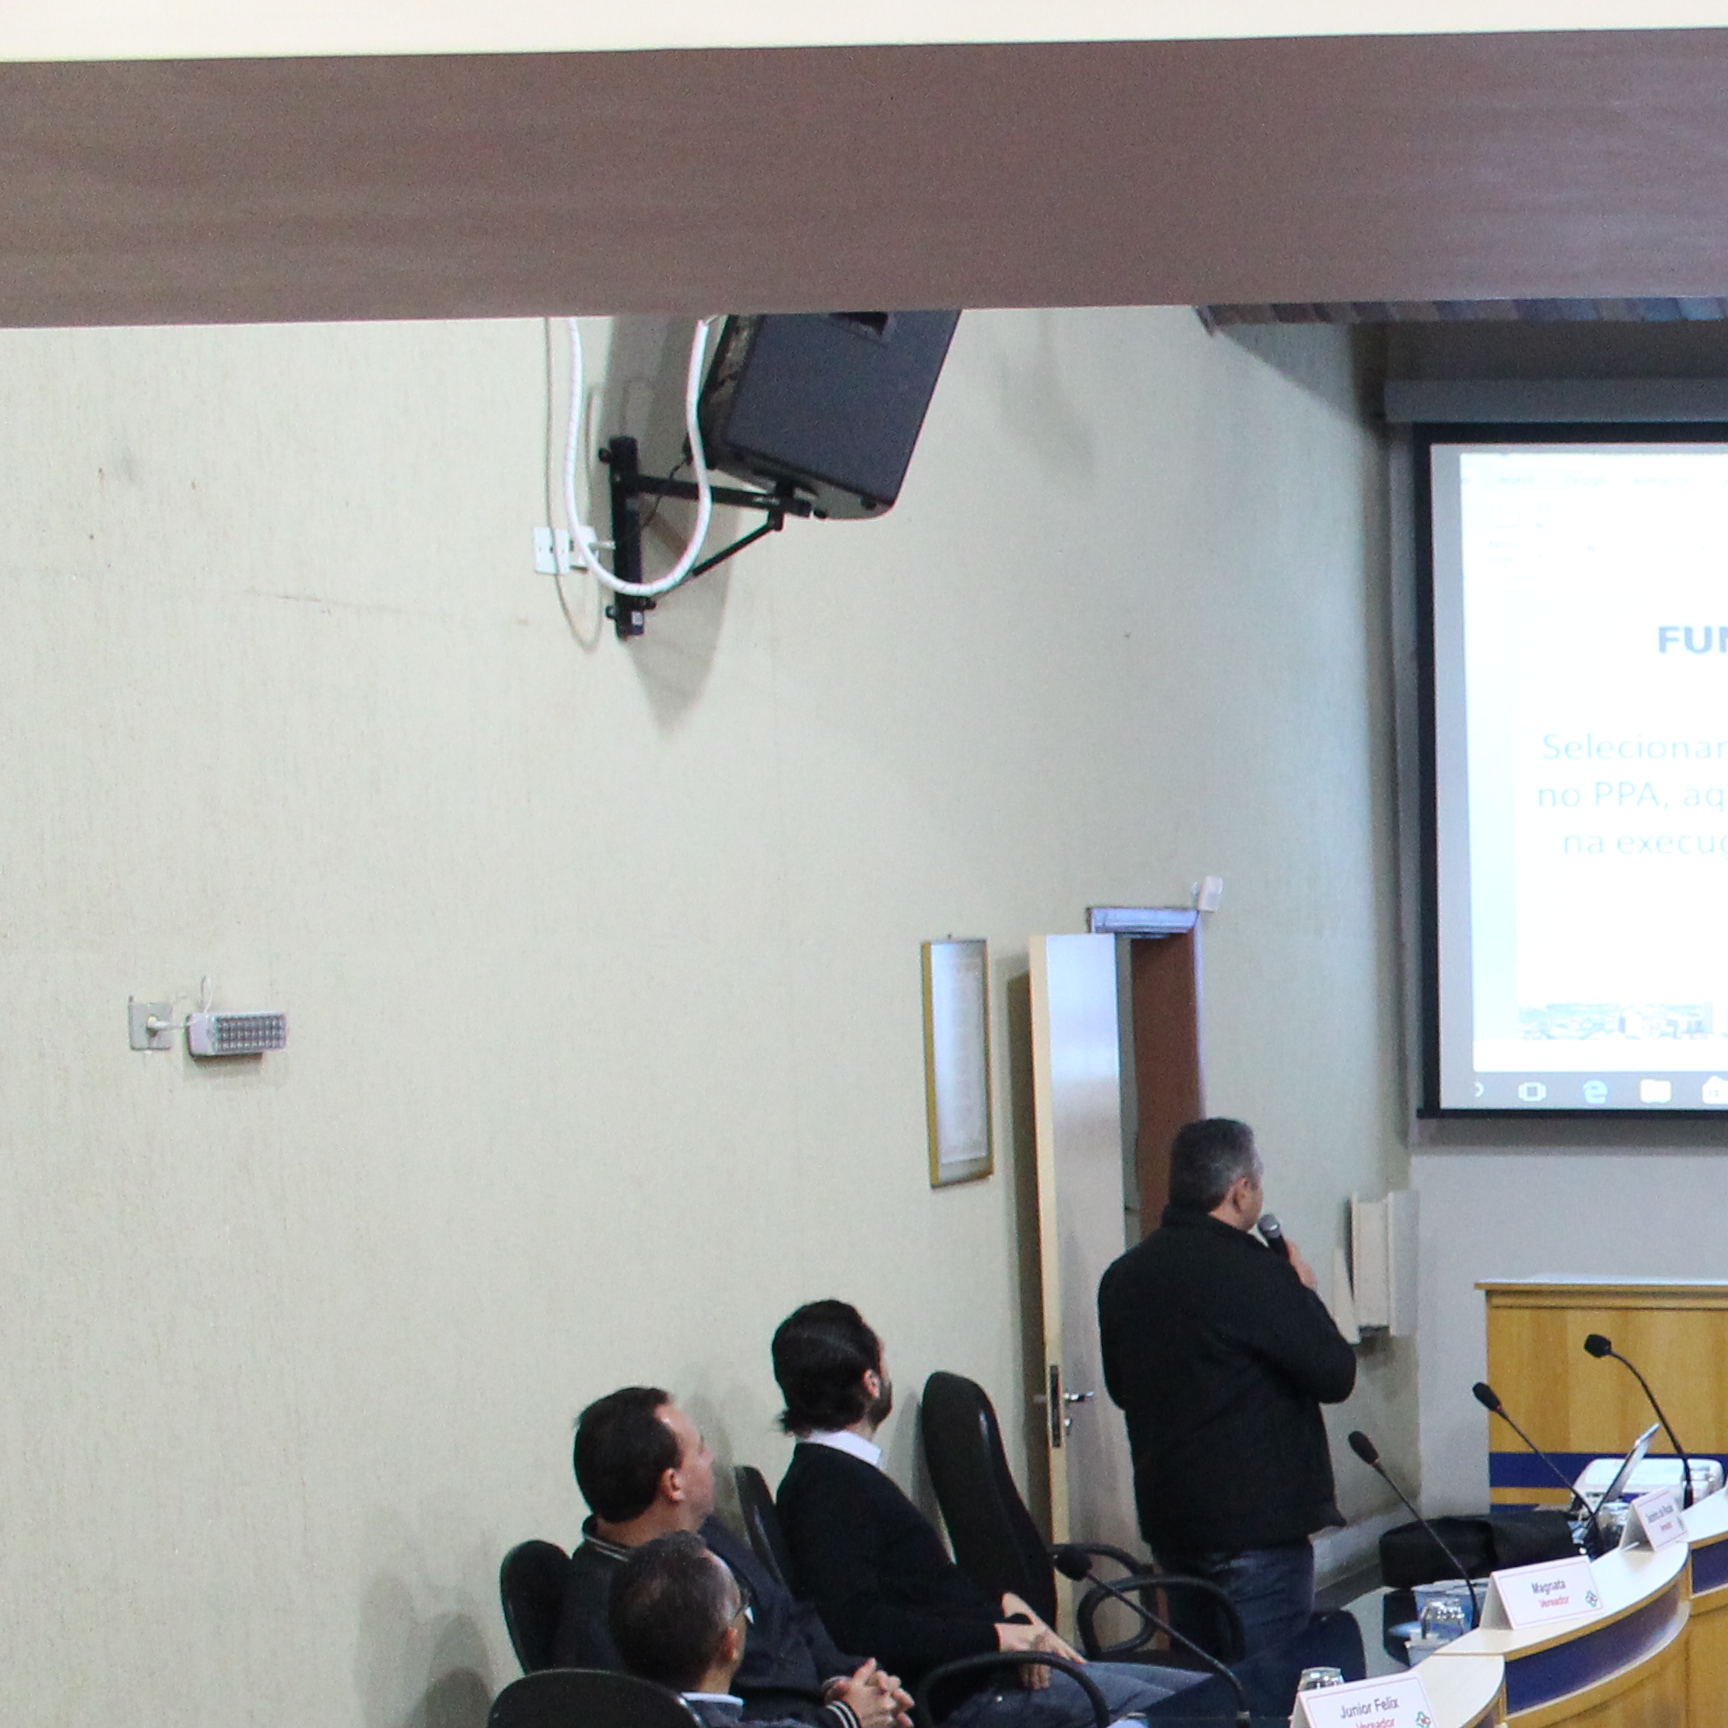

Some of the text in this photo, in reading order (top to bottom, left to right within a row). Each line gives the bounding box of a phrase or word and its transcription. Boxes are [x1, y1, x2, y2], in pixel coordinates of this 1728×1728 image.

[1538, 788, 1581, 807] no
[1595, 780, 1669, 809] PPA,
[1563, 835, 1605, 854] na
